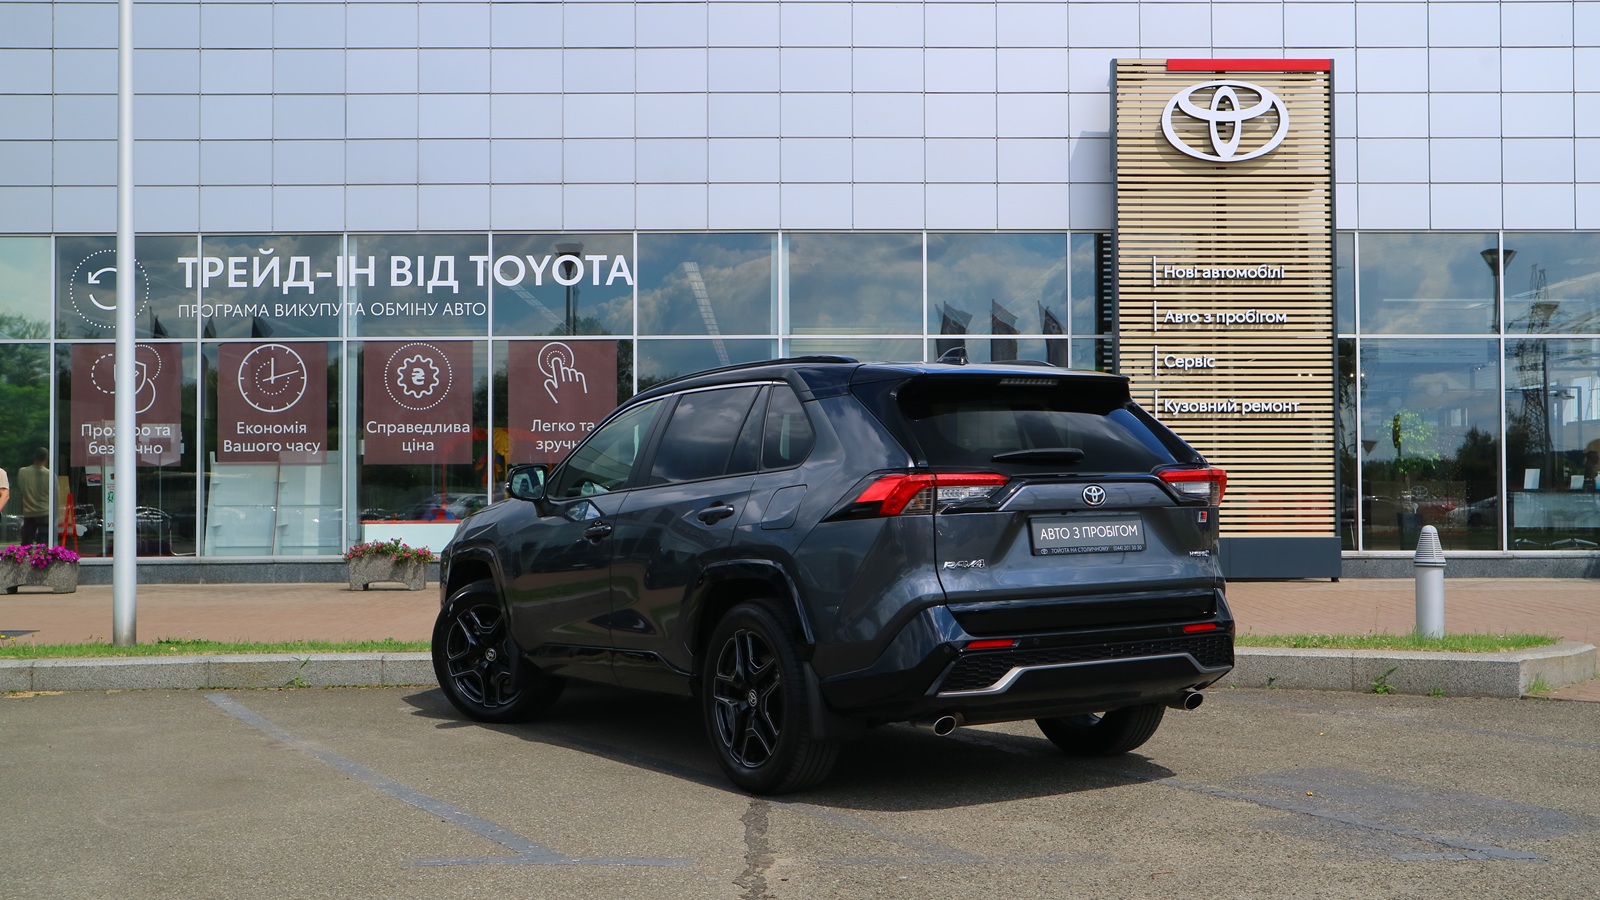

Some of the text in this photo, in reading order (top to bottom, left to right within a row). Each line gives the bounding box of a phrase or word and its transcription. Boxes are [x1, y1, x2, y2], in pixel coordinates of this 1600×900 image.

[177, 247, 634, 295] ТРЕЙД-ІН ВІД TOYOTA
[1163, 264, 1285, 279] Нові автомобілі
[178, 302, 487, 318] ПРОГРАМА ВИКУПУ ТА ОБМІНУ АВТО
[1163, 309, 1288, 326] Авто з пробігом
[1163, 354, 1216, 371] Сервіс
[1163, 398, 1301, 415] Кузовний ремонт
[81, 423, 171, 440] Проо та
[236, 421, 307, 434] Економія
[366, 420, 471, 436] Справедлива
[530, 419, 596, 432] Легко та
[88, 441, 163, 455] безчно
[223, 439, 321, 455] Вашого часу
[402, 439, 435, 453] ціна
[1040, 526, 1071, 541] АВТО
[1082, 524, 1139, 538] ПРОБІГОМ
[942, 558, 986, 570] RAV4
